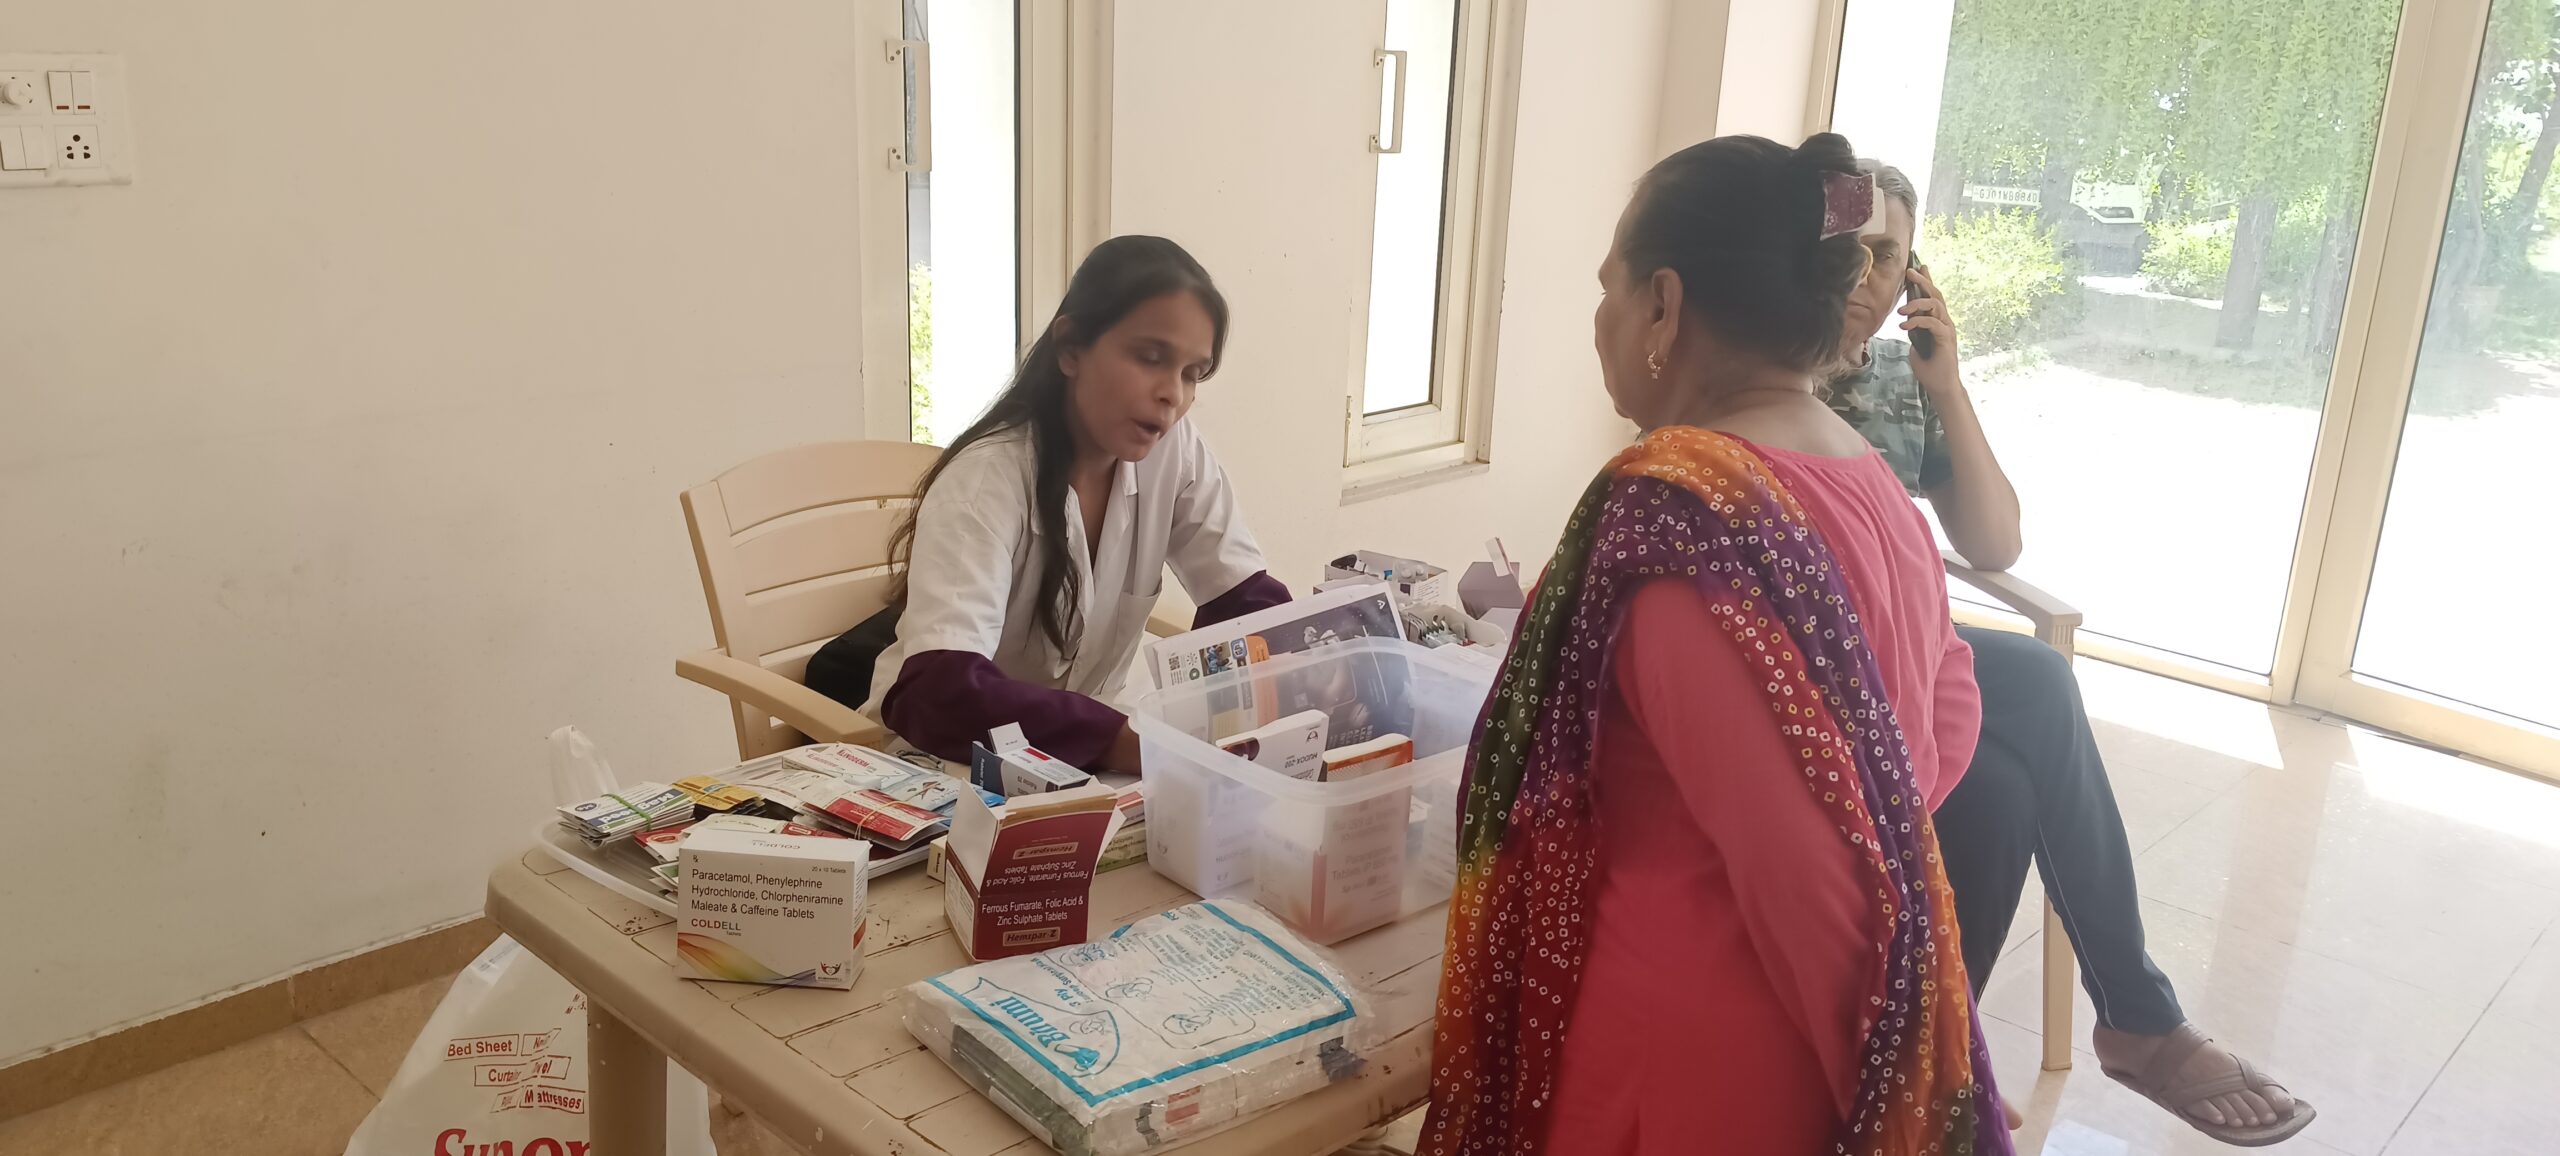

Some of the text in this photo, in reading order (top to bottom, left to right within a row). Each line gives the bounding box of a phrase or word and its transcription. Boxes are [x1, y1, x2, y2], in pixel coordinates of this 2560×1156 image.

[691, 869, 823, 890] Paracetamol, Phenylephrine
[691, 885, 844, 906] Hydrochloride, Chlorpheniramine
[981, 895, 1084, 914] Ferrous Fumarate, Folic Acid &
[691, 900, 815, 920] Maleate & Caffeine Tablets
[997, 910, 1068, 926] Zinc Sulphate Tablets
[691, 918, 741, 931] COLDELL
[447, 1039, 513, 1057] Bed Sheet
